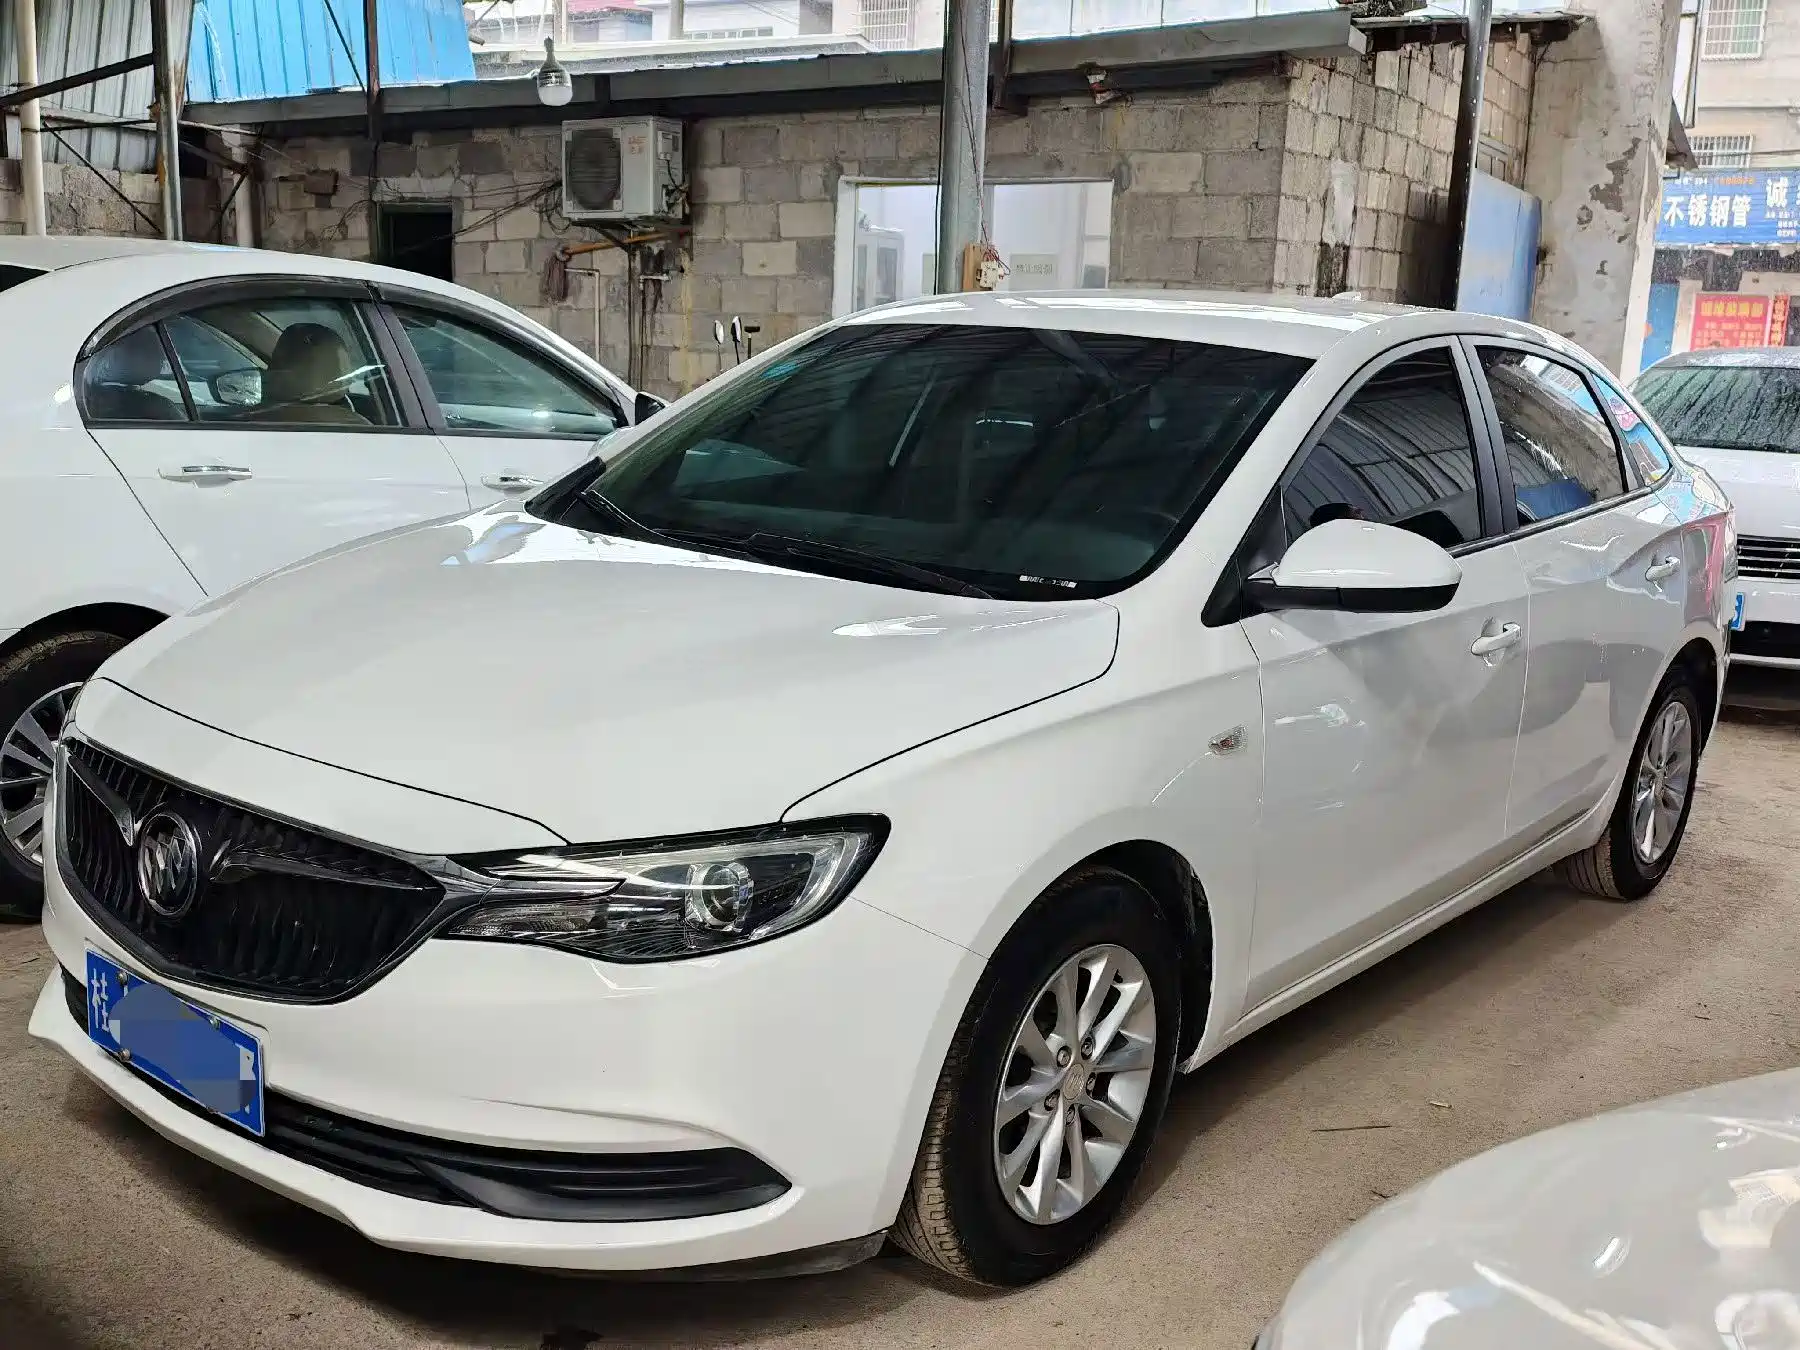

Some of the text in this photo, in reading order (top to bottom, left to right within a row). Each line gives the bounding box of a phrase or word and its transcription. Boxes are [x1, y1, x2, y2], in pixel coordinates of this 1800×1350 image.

[1765, 176, 1800, 208] 诚
[1664, 194, 1751, 227] 不锈钢管
